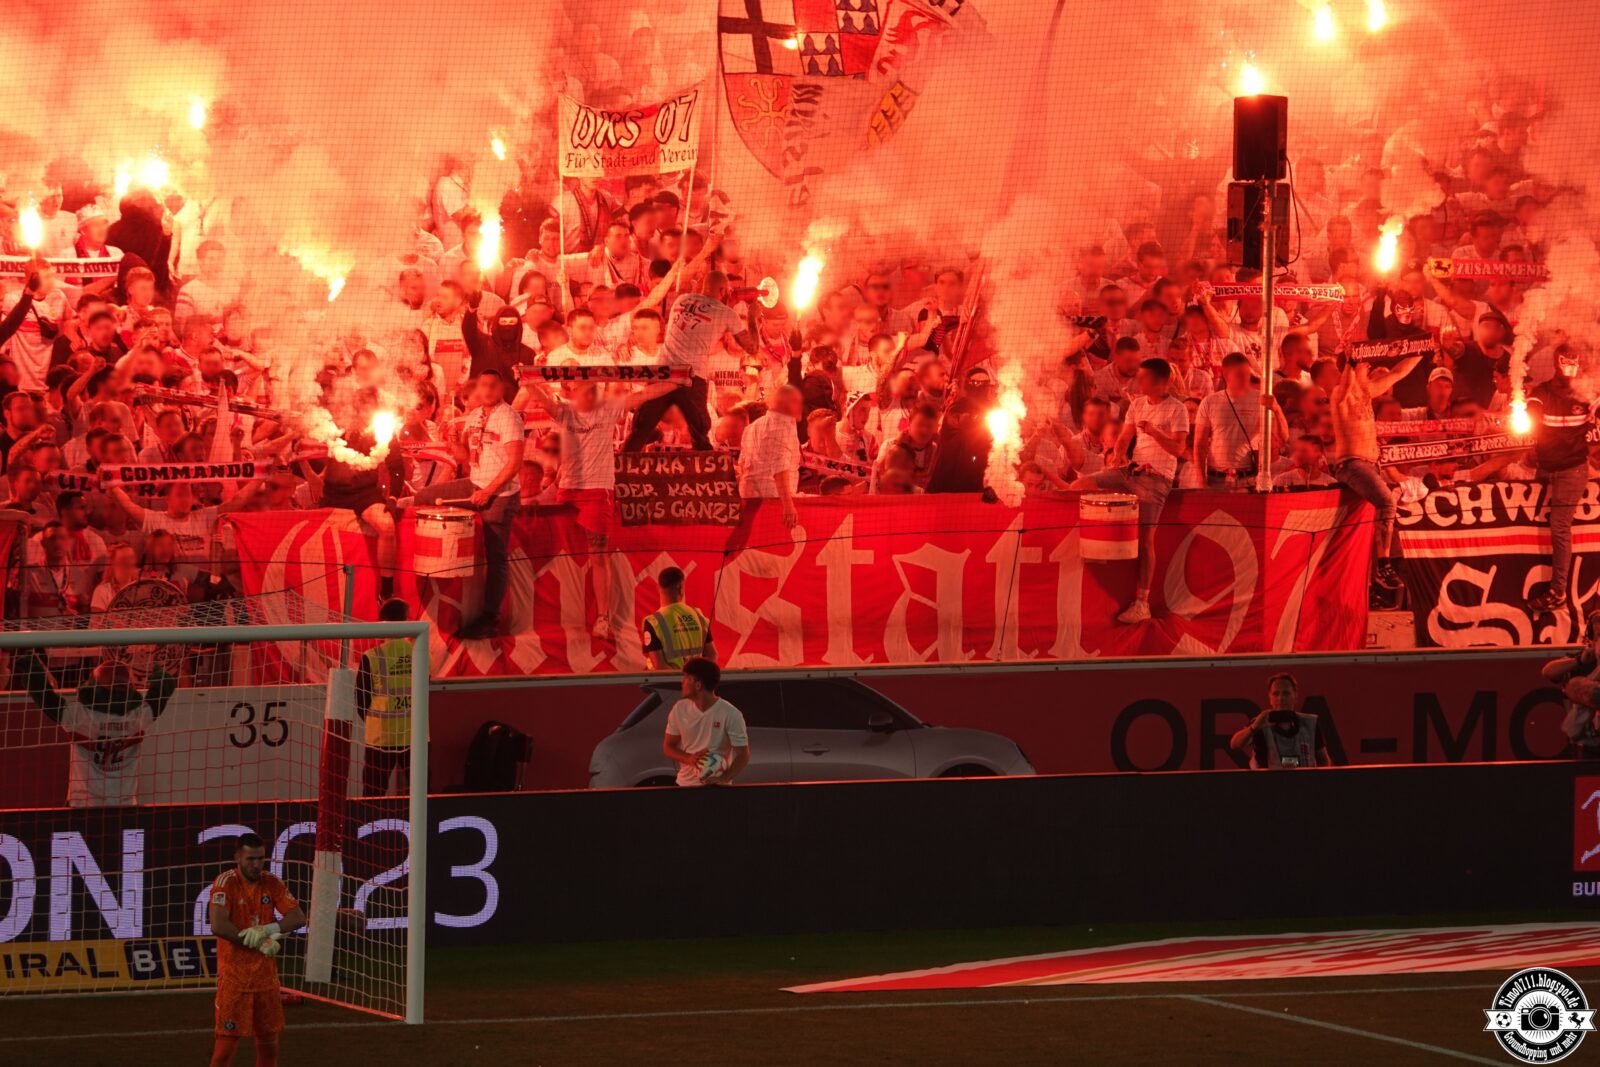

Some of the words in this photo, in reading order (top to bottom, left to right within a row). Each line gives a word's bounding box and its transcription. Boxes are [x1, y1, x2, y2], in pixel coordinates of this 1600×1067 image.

[654, 90, 698, 144] 07
[565, 152, 589, 168] Für
[593, 150, 627, 169] Stadt
[628, 150, 656, 165] und
[715, 371, 742, 379] NIEMA
[120, 463, 254, 481] COMMANDO
[615, 483, 658, 497] DER
[667, 481, 737, 497] KAMPF
[622, 502, 665, 520] UMS
[671, 501, 740, 523] GANZE
[229, 701, 289, 748] 35
